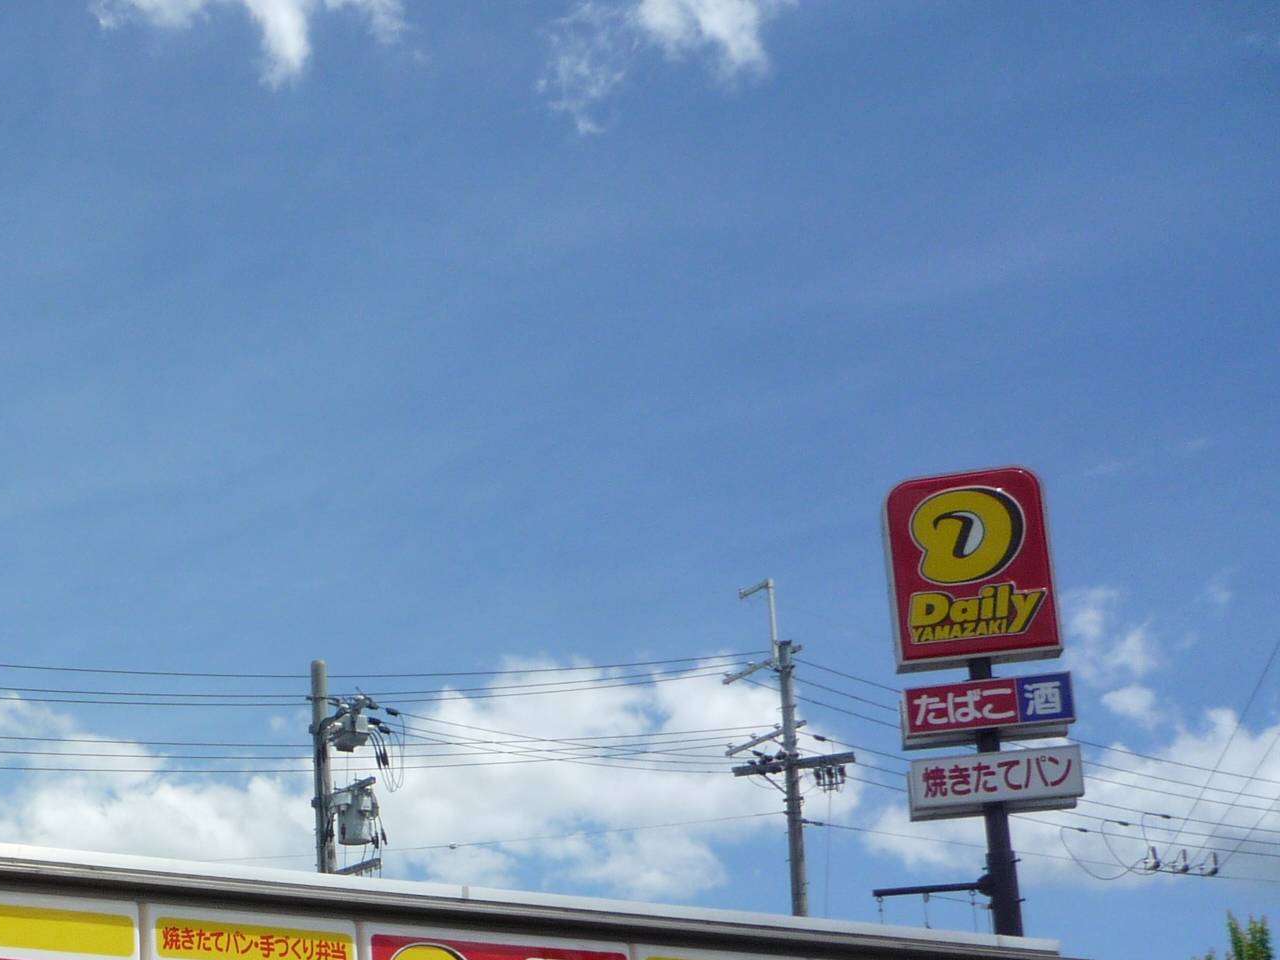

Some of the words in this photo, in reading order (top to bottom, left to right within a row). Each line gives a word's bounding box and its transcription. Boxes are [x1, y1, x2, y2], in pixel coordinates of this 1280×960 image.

[909, 581, 1047, 634] Daily
[911, 618, 1008, 644] YAMAZAKI
[914, 688, 1016, 726] たばこ
[1023, 681, 1062, 717] 酒
[923, 756, 1072, 798] 焼きたてパン
